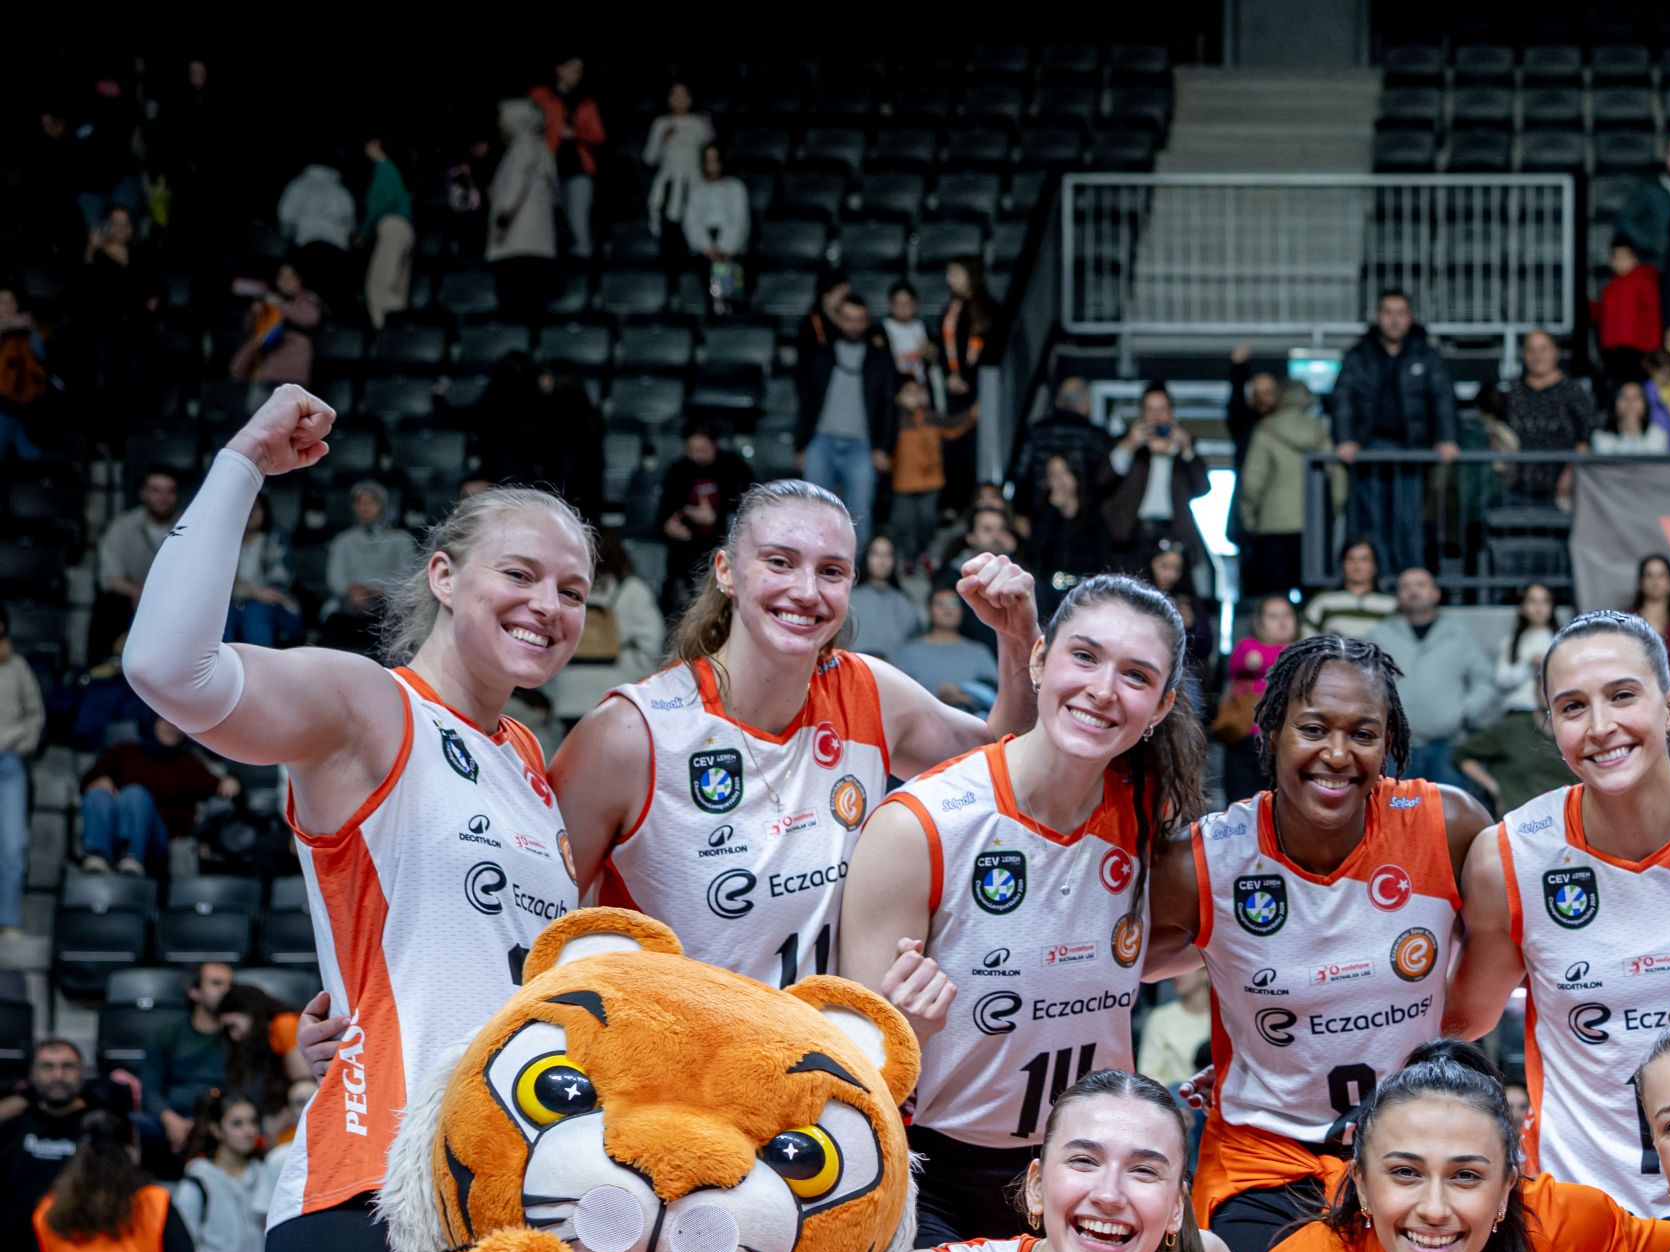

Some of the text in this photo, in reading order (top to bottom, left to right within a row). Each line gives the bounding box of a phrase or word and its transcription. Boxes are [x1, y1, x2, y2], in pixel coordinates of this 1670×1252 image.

[693, 756, 714, 767] CEV
[459, 832, 502, 849] DECATHLON
[698, 844, 748, 858] DECATHLON
[978, 857, 1000, 867] CEV
[1548, 874, 1570, 884] CEV
[1239, 880, 1261, 890] CEV
[972, 968, 1021, 977] DECATHLON
[1557, 980, 1603, 990] DECATHLON
[1244, 987, 1290, 996] DECATHLON
[1032, 988, 1137, 1021] Eczacıba
[1310, 994, 1434, 1036] Eczacıbaşı
